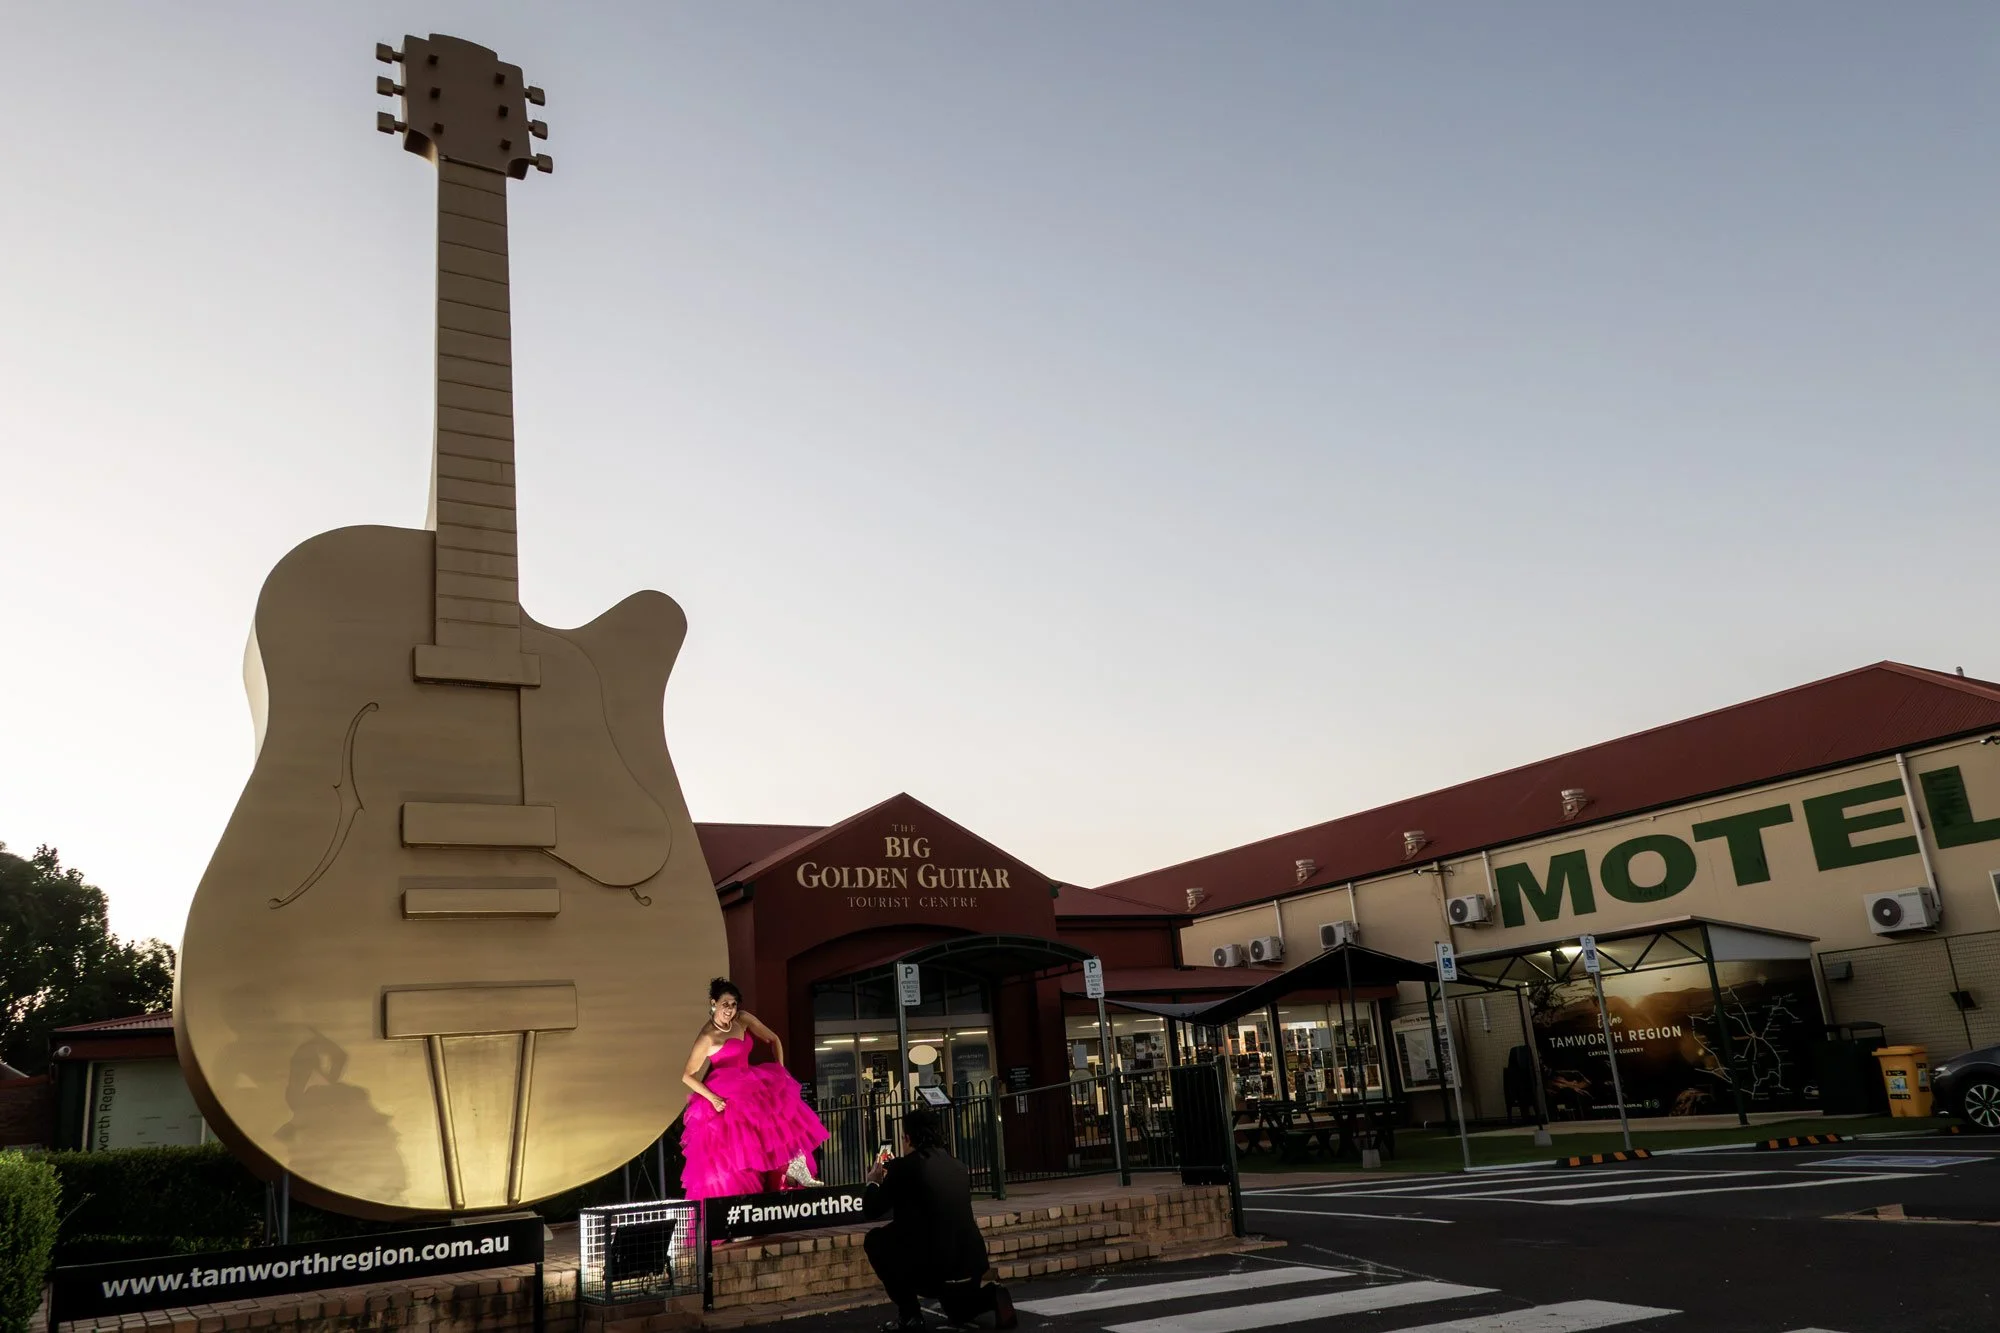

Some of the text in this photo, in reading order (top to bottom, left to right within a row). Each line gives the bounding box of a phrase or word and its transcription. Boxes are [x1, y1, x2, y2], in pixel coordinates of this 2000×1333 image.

[892, 824, 917, 833] THE
[884, 836, 931, 859] BIG
[1494, 765, 2000, 929] MOTEL
[796, 862, 1012, 889] GOLDEN GUITAR
[847, 896, 979, 908] TOURIST CENTRE
[1442, 946, 1449, 956] P
[905, 966, 914, 979] P
[1088, 961, 1097, 973] P
[1549, 1025, 1682, 1049] TAMWORH REGION
[99, 1068, 116, 1112] Region
[726, 1194, 864, 1225] #TamworthRe
[102, 1235, 510, 1299] www.tamworthregion.com.au
